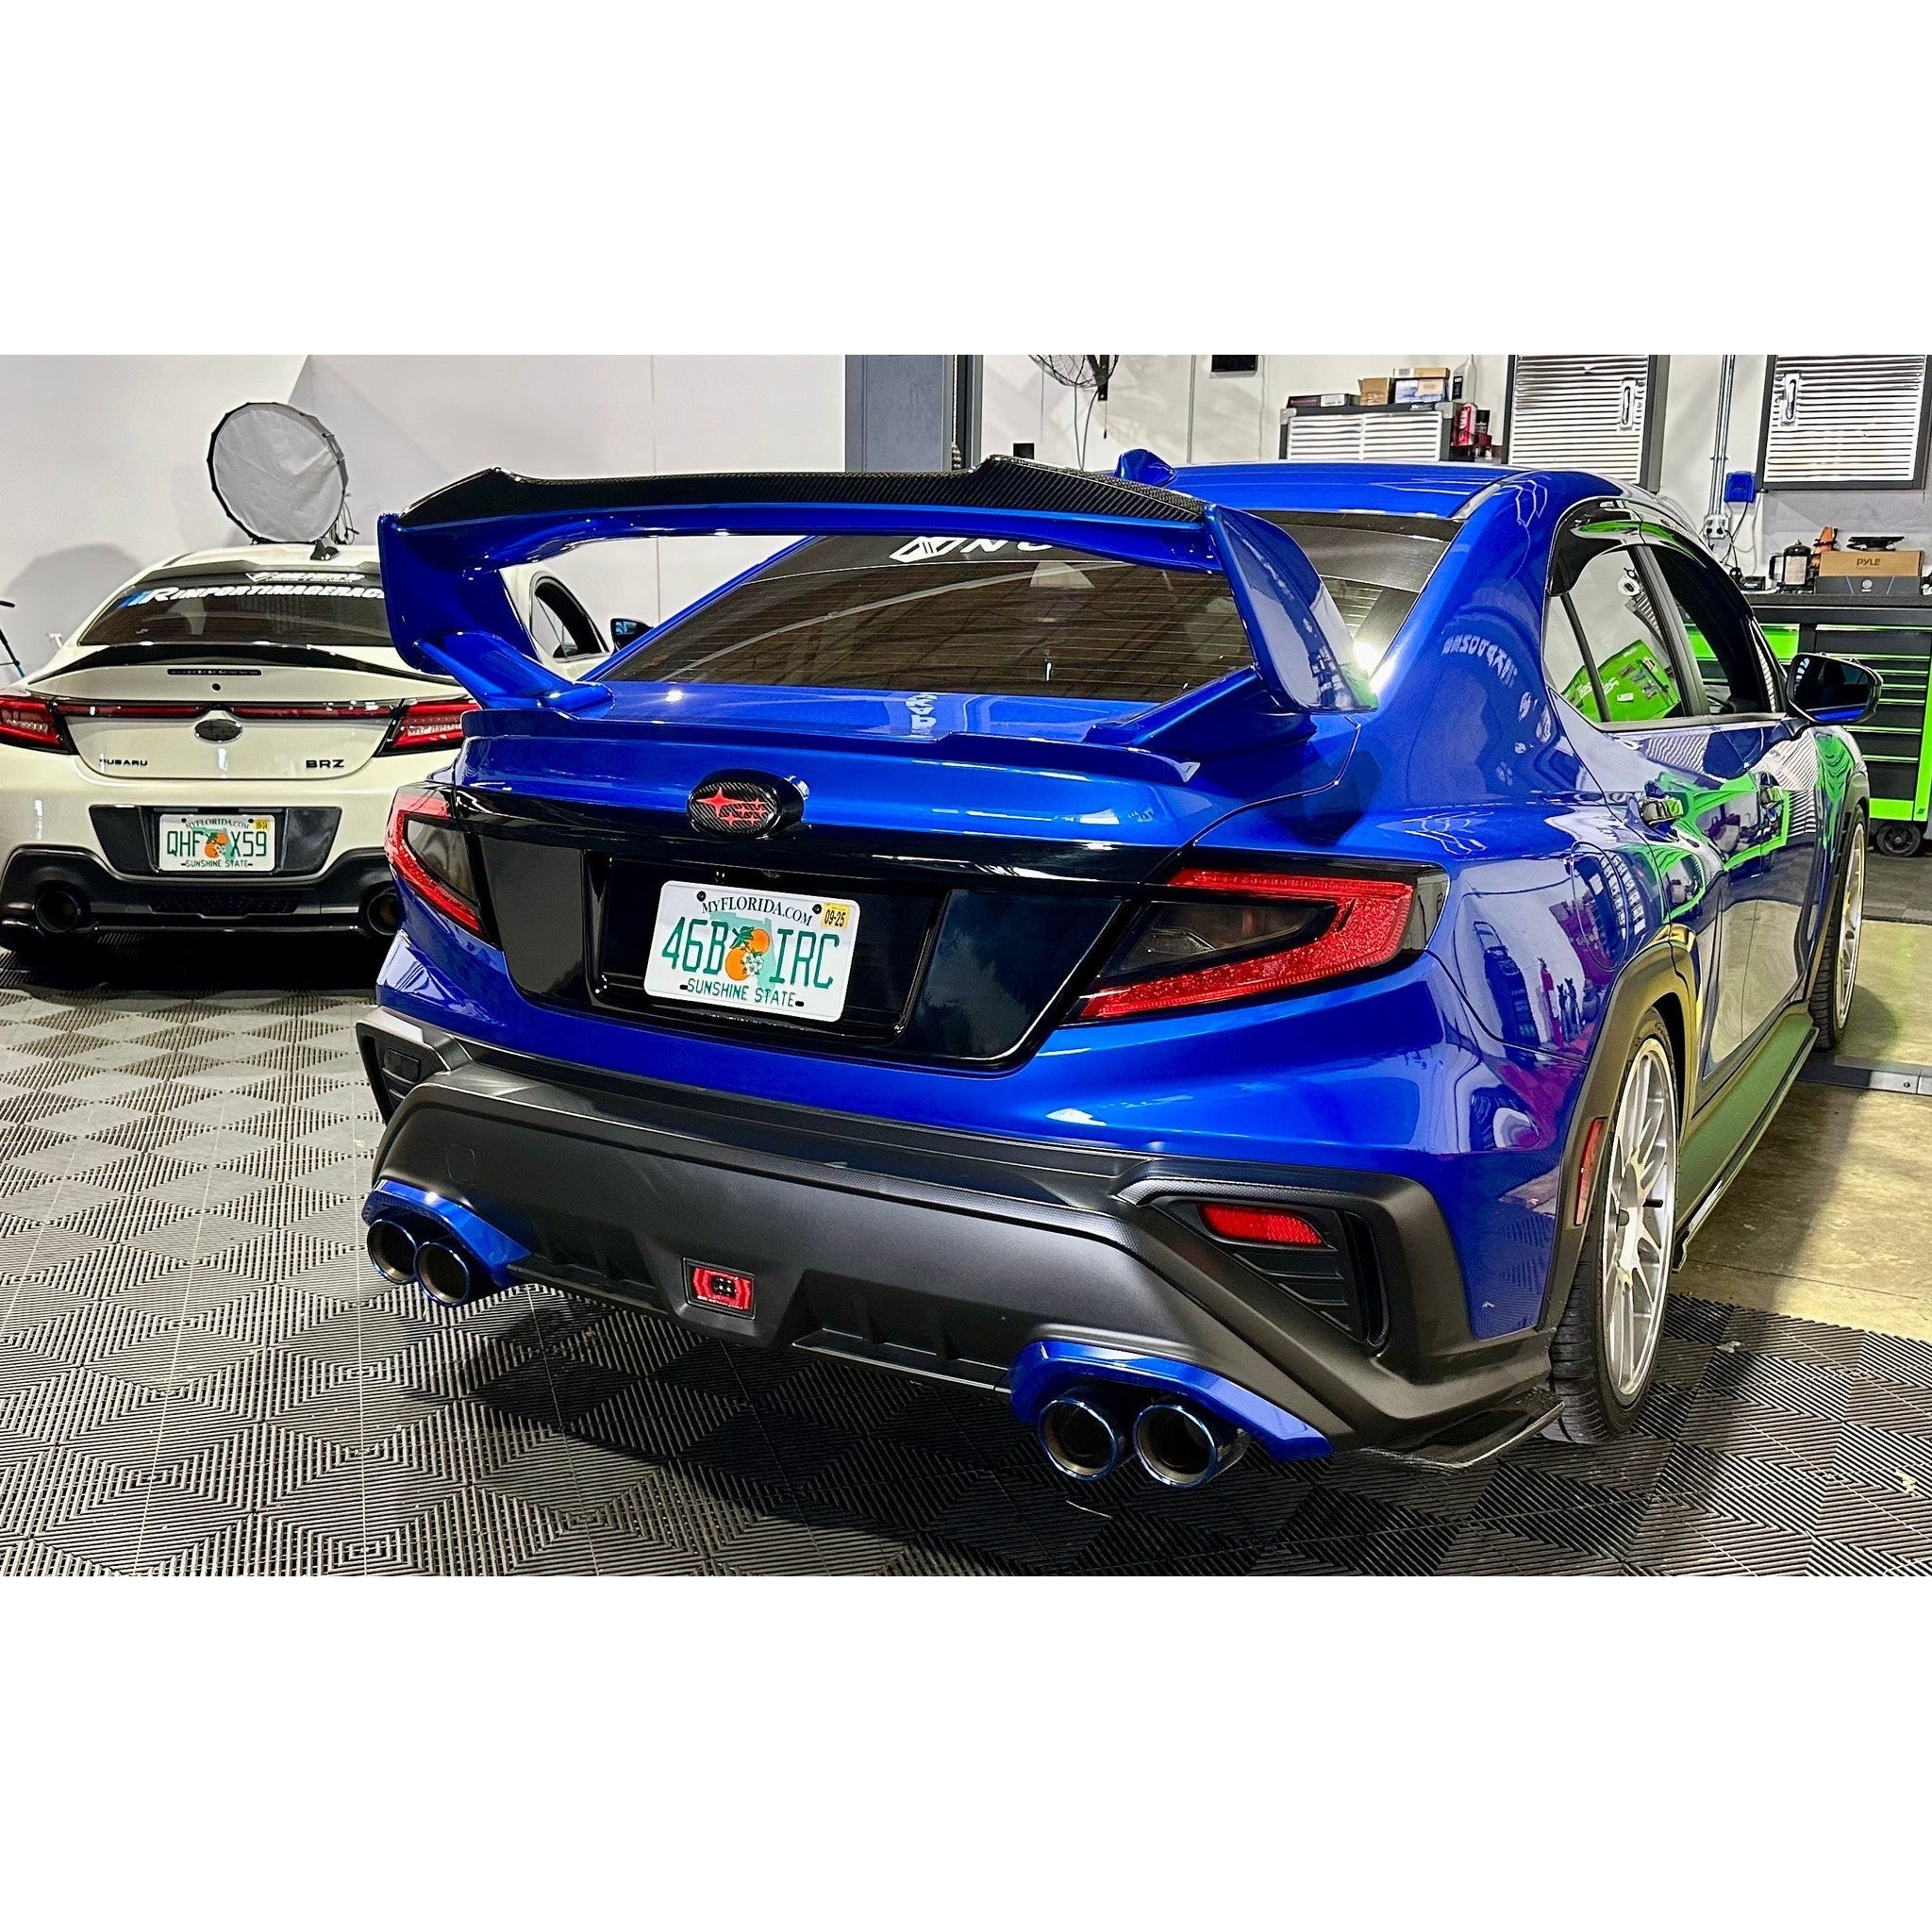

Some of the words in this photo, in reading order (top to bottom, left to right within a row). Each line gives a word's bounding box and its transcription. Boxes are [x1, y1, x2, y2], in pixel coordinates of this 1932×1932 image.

[1857, 558, 1880, 566] PYLE
[306, 759, 344, 769] BRZ
[186, 817, 249, 829] MYFLORIDA.COM
[167, 831, 205, 857] QHF
[230, 831, 267, 857] X59
[186, 859, 222, 868] SUNSHINE
[225, 859, 249, 868] STATE
[702, 896, 813, 926] MYFLORIDA.COM
[824, 908, 846, 927] 09-25
[661, 916, 730, 975] 46B
[768, 928, 841, 990] IRC
[687, 978, 749, 1001] SUNSHINE
[754, 988, 795, 1008] STATE
